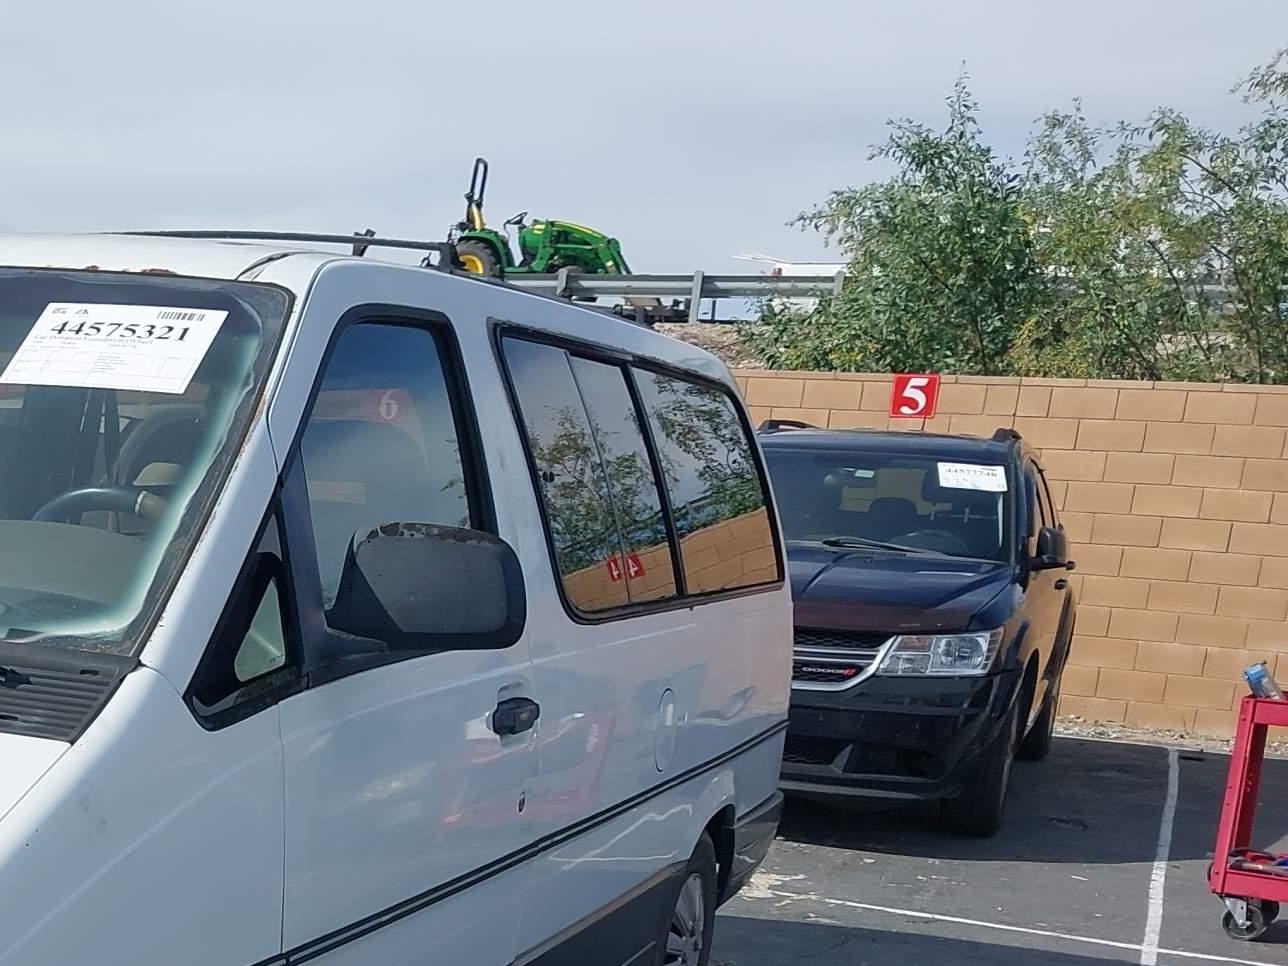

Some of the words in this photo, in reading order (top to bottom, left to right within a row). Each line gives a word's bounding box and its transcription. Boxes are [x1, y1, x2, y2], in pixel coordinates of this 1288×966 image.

[50, 321, 191, 341] 44575321
[380, 389, 399, 420] 6
[899, 377, 931, 415] 5
